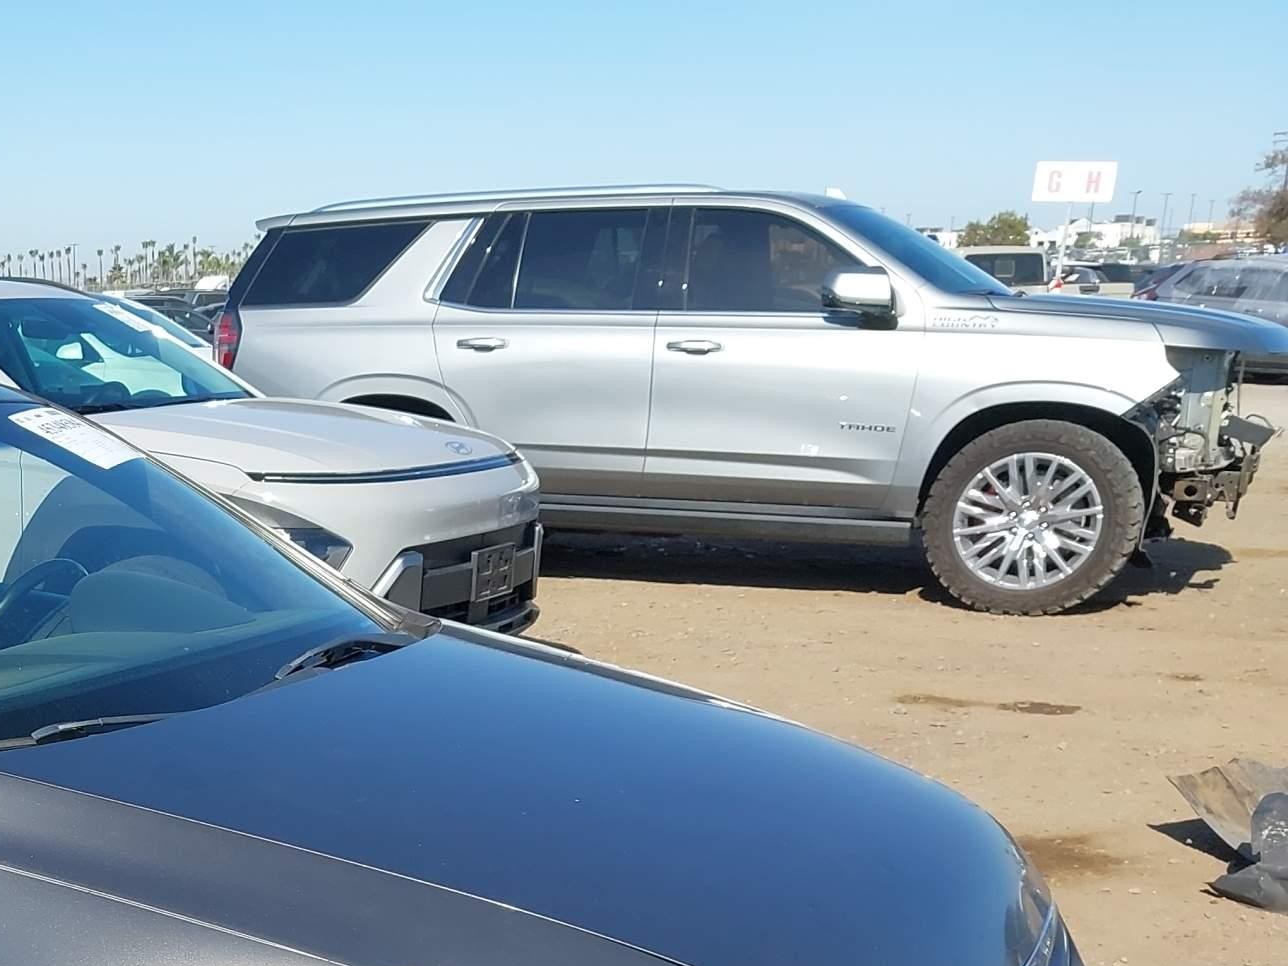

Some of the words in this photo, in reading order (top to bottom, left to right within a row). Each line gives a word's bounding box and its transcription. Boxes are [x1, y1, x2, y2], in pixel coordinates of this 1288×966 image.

[1048, 170, 1063, 193] G
[1086, 171, 1102, 193] H
[838, 422, 897, 433] TAHOE
